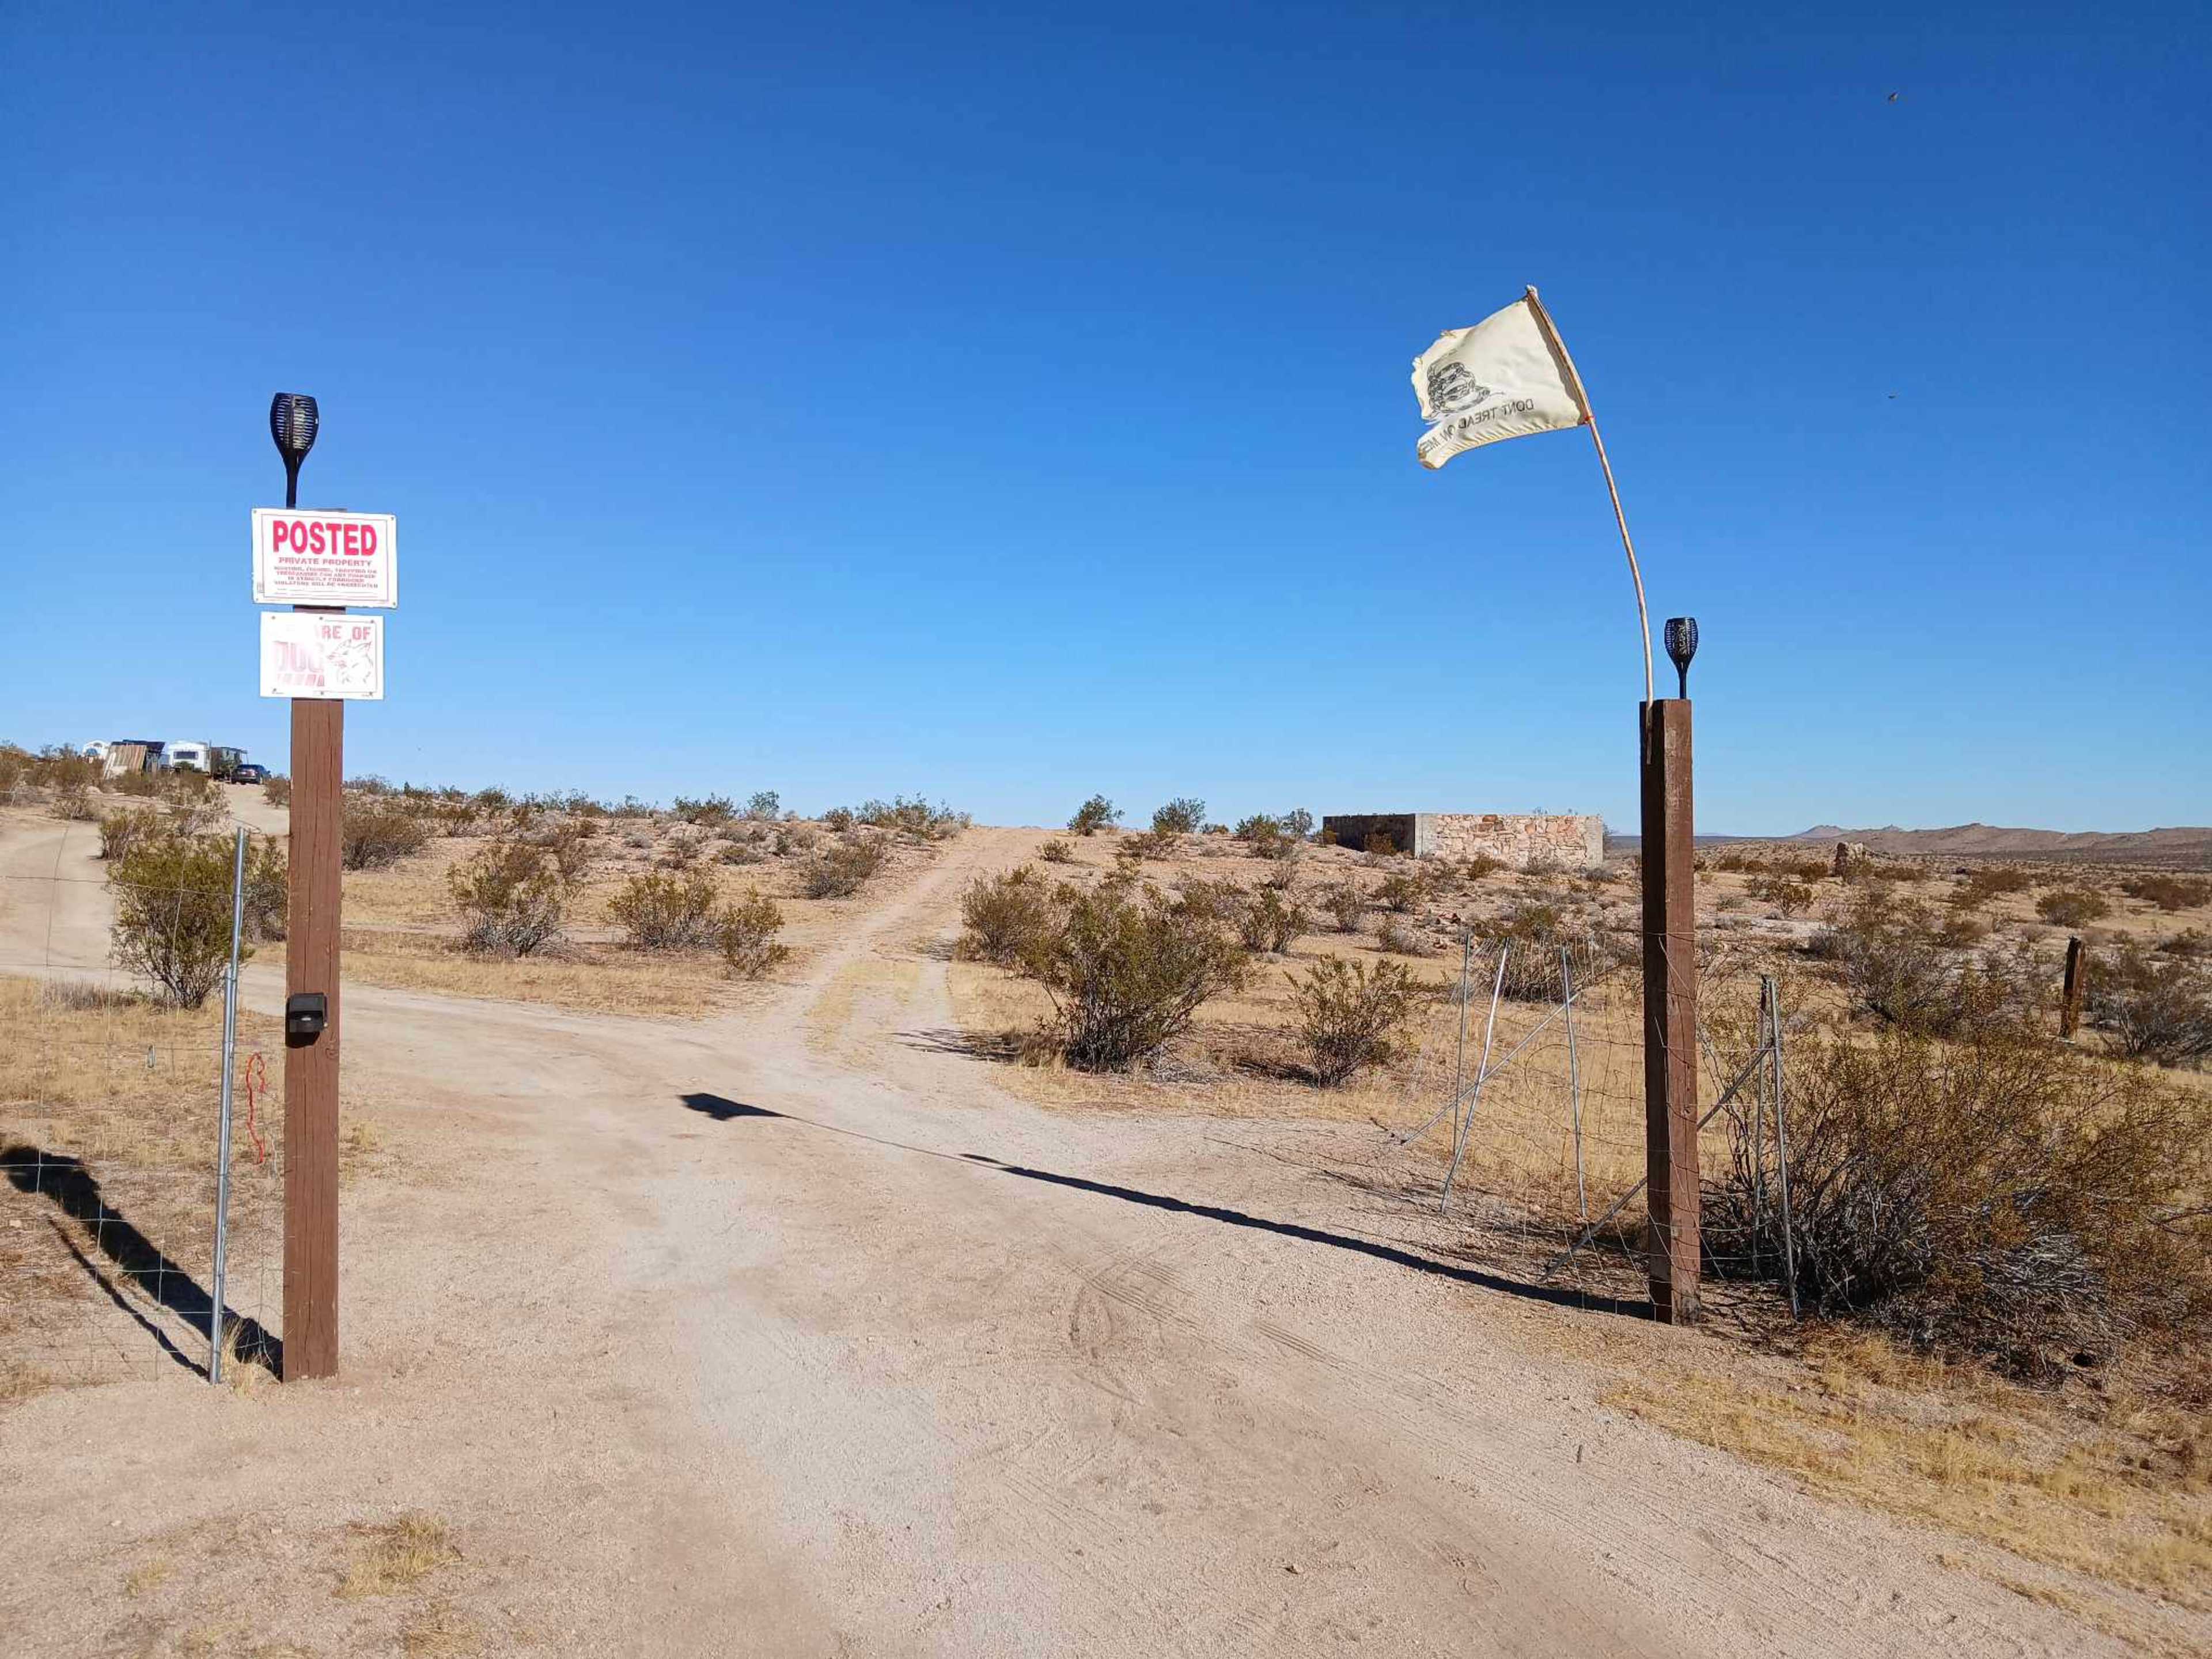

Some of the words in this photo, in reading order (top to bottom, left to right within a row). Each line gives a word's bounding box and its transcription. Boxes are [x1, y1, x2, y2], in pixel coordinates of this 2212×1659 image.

[273, 520, 377, 556] POSTED
[279, 557, 319, 565] PRIVATE
[323, 558, 372, 567] PROPERTY
[352, 626, 372, 640] OF
